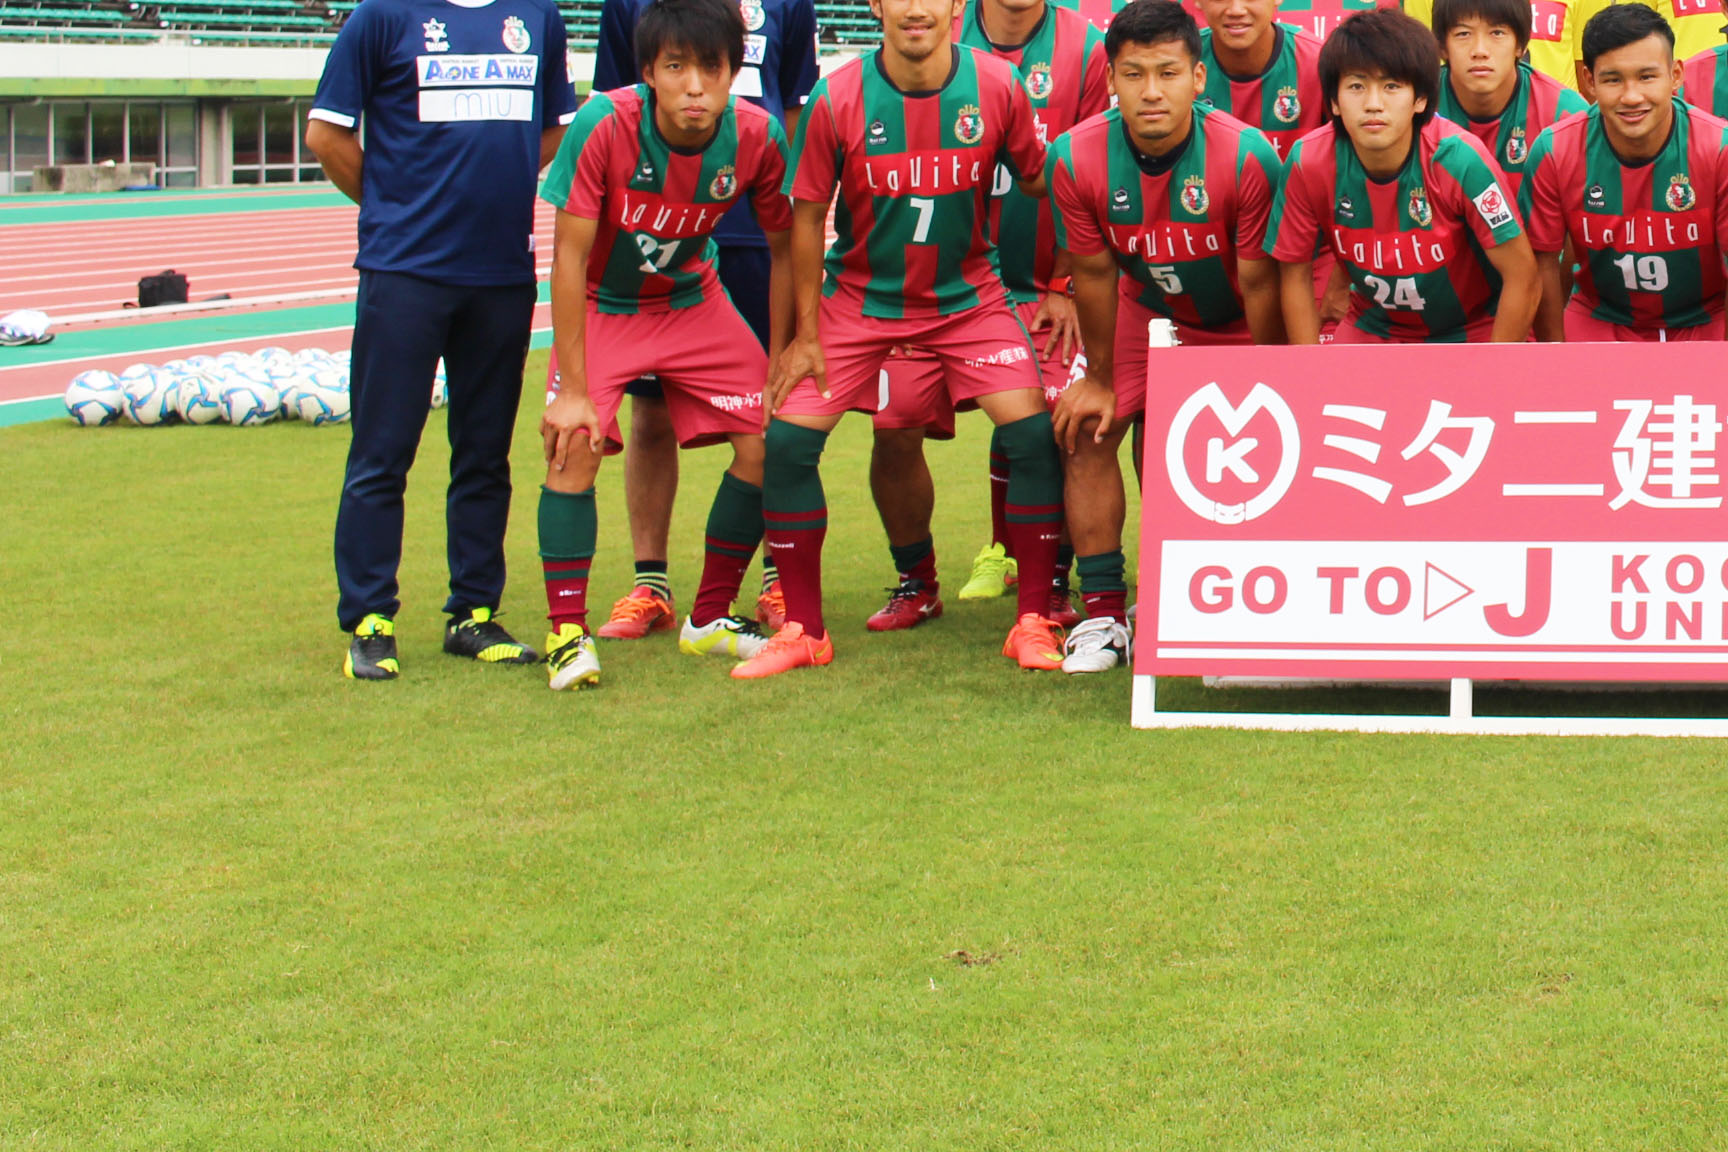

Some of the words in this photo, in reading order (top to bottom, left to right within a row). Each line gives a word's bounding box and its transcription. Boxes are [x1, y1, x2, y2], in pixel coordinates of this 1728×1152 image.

[909, 197, 935, 243] 7
[1148, 265, 1184, 295] 5
[1613, 254, 1670, 291] 19
[1363, 274, 1426, 311] 24
[1188, 565, 1289, 615] GO
[1316, 565, 1412, 616] TO
[1482, 547, 1553, 638] J
